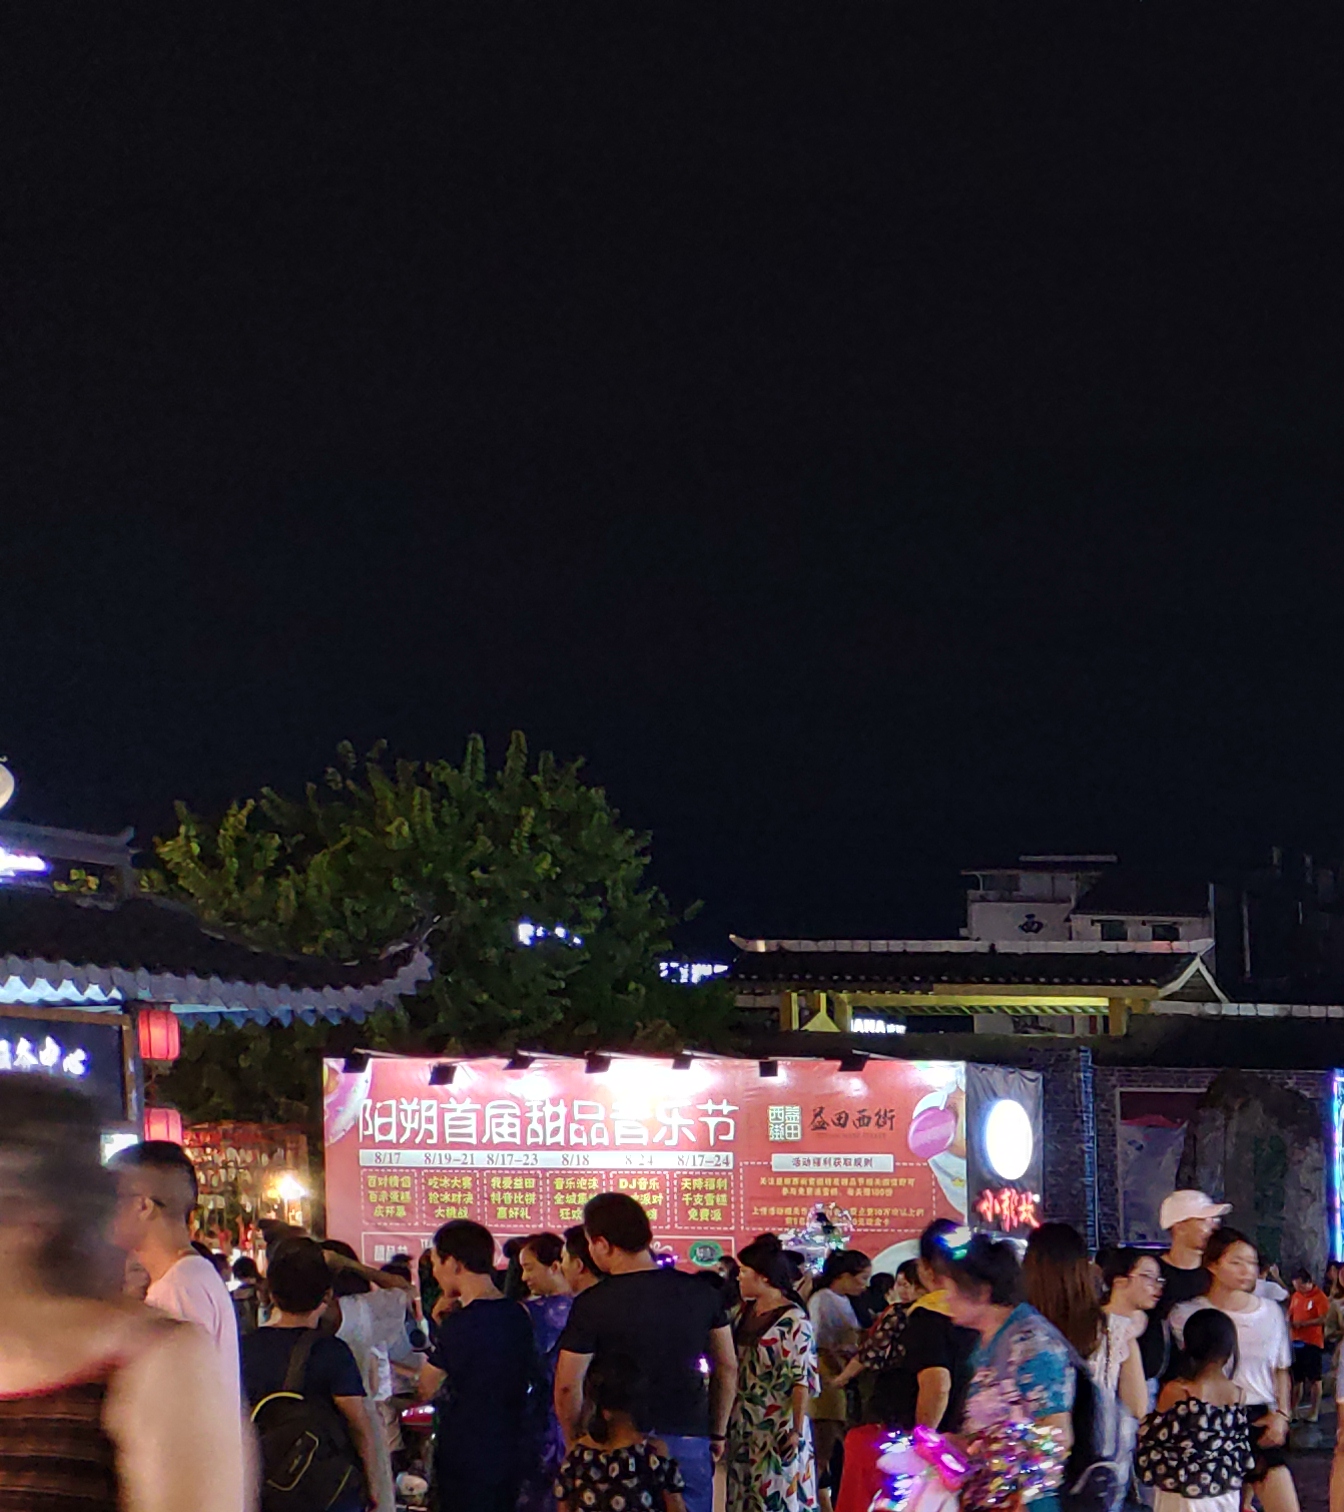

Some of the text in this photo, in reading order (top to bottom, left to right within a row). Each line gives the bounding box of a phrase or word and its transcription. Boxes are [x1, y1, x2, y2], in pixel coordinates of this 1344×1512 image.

[359, 1097, 739, 1146] 阳朔首届甜品音乐节
[374, 1152, 401, 1165] 8/17
[561, 1153, 590, 1166] 8/18
[618, 1176, 659, 1190] DJ音乐
